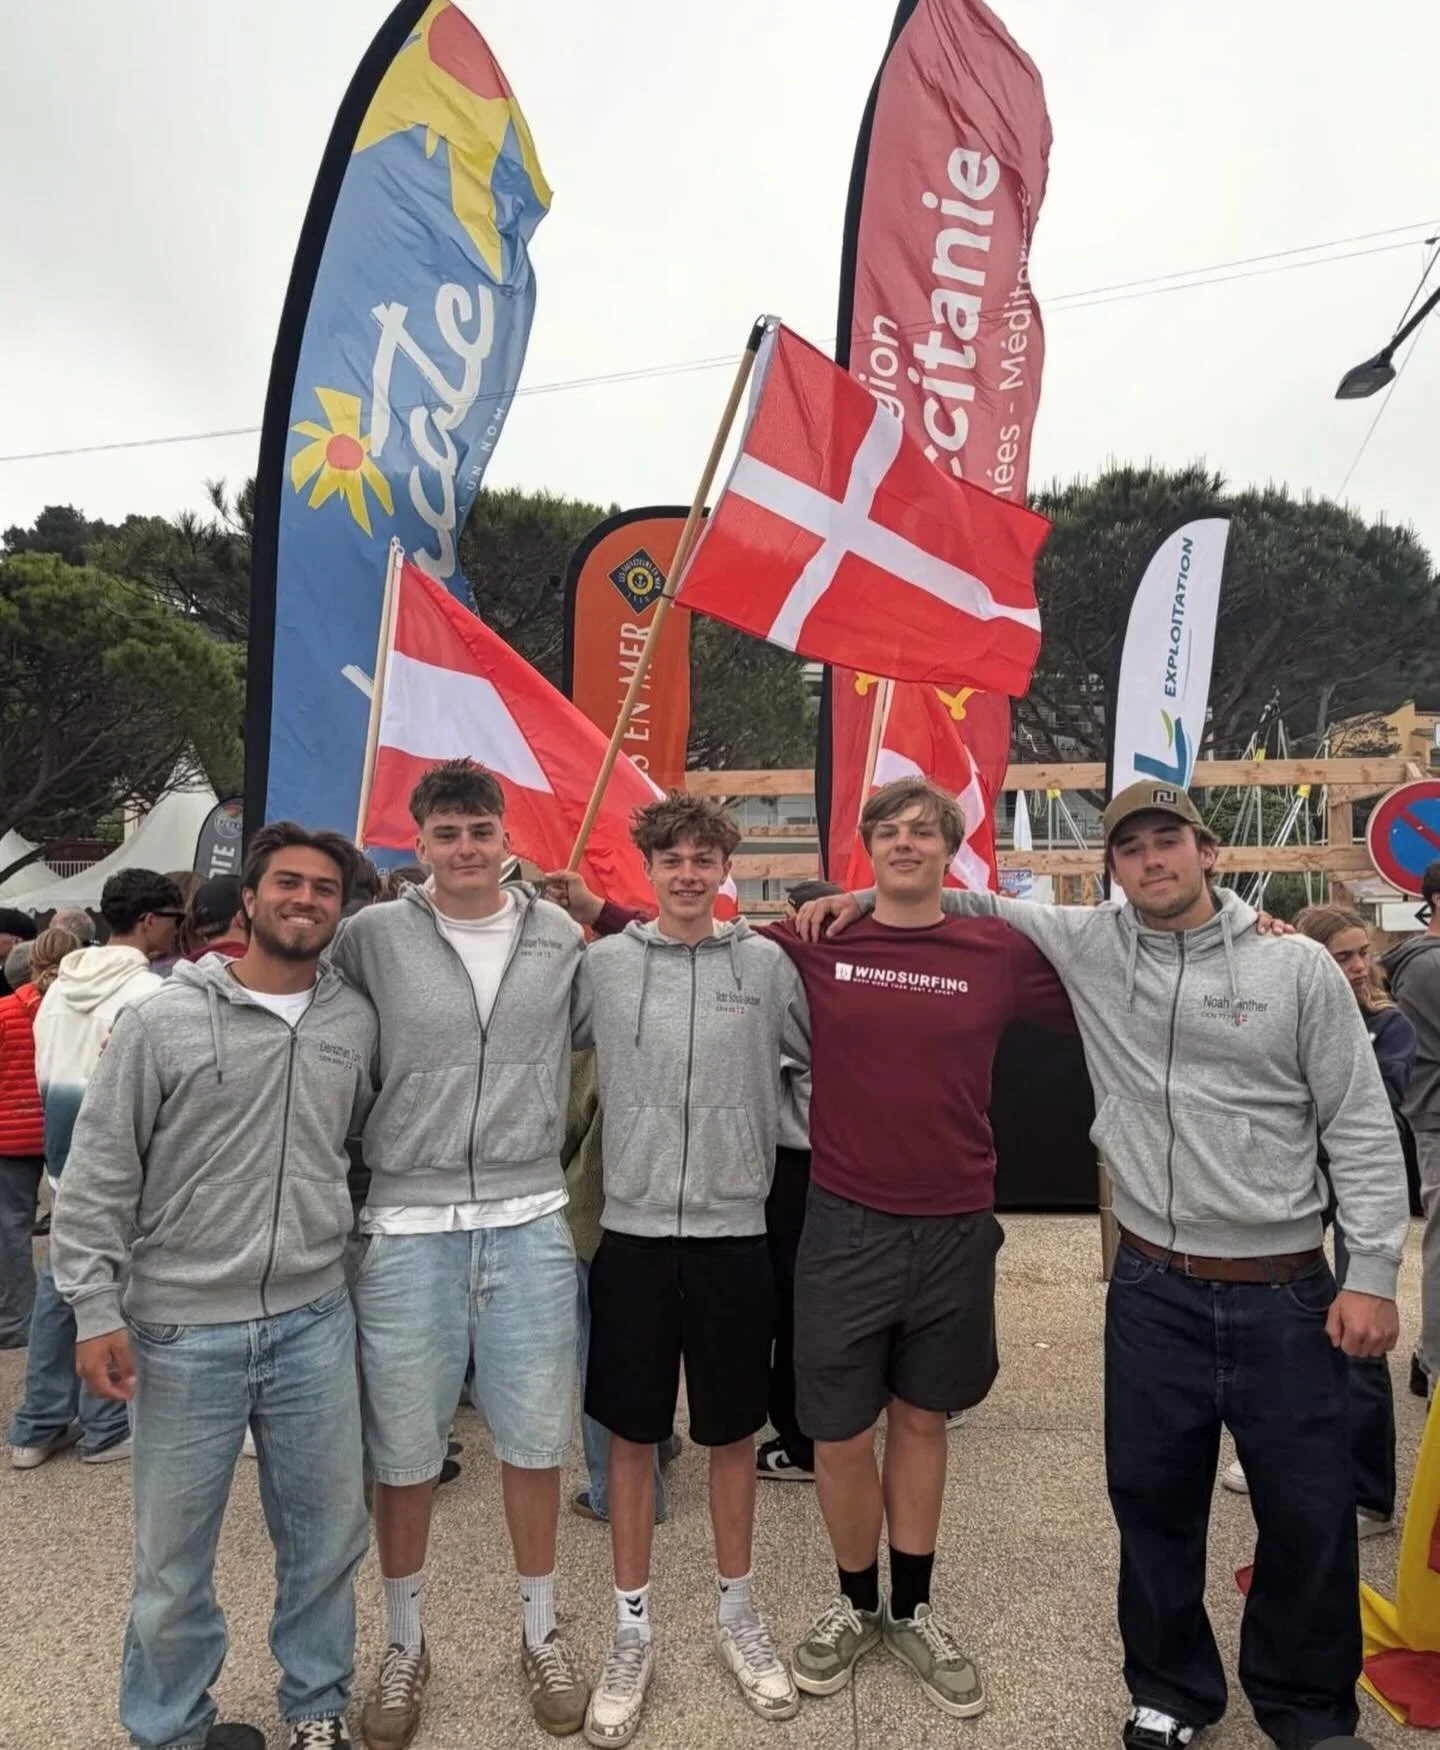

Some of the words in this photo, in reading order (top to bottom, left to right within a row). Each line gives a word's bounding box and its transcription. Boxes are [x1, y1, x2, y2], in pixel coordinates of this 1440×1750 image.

[907, 146, 1000, 478] citanie
[859, 315, 904, 421] gion
[466, 465, 483, 491] UN
[481, 408, 504, 452] NOM
[1164, 537, 1194, 698] EXPLOITATION
[855, 965, 969, 993] WINDSURFING
[1203, 994, 1230, 1010] Noah
